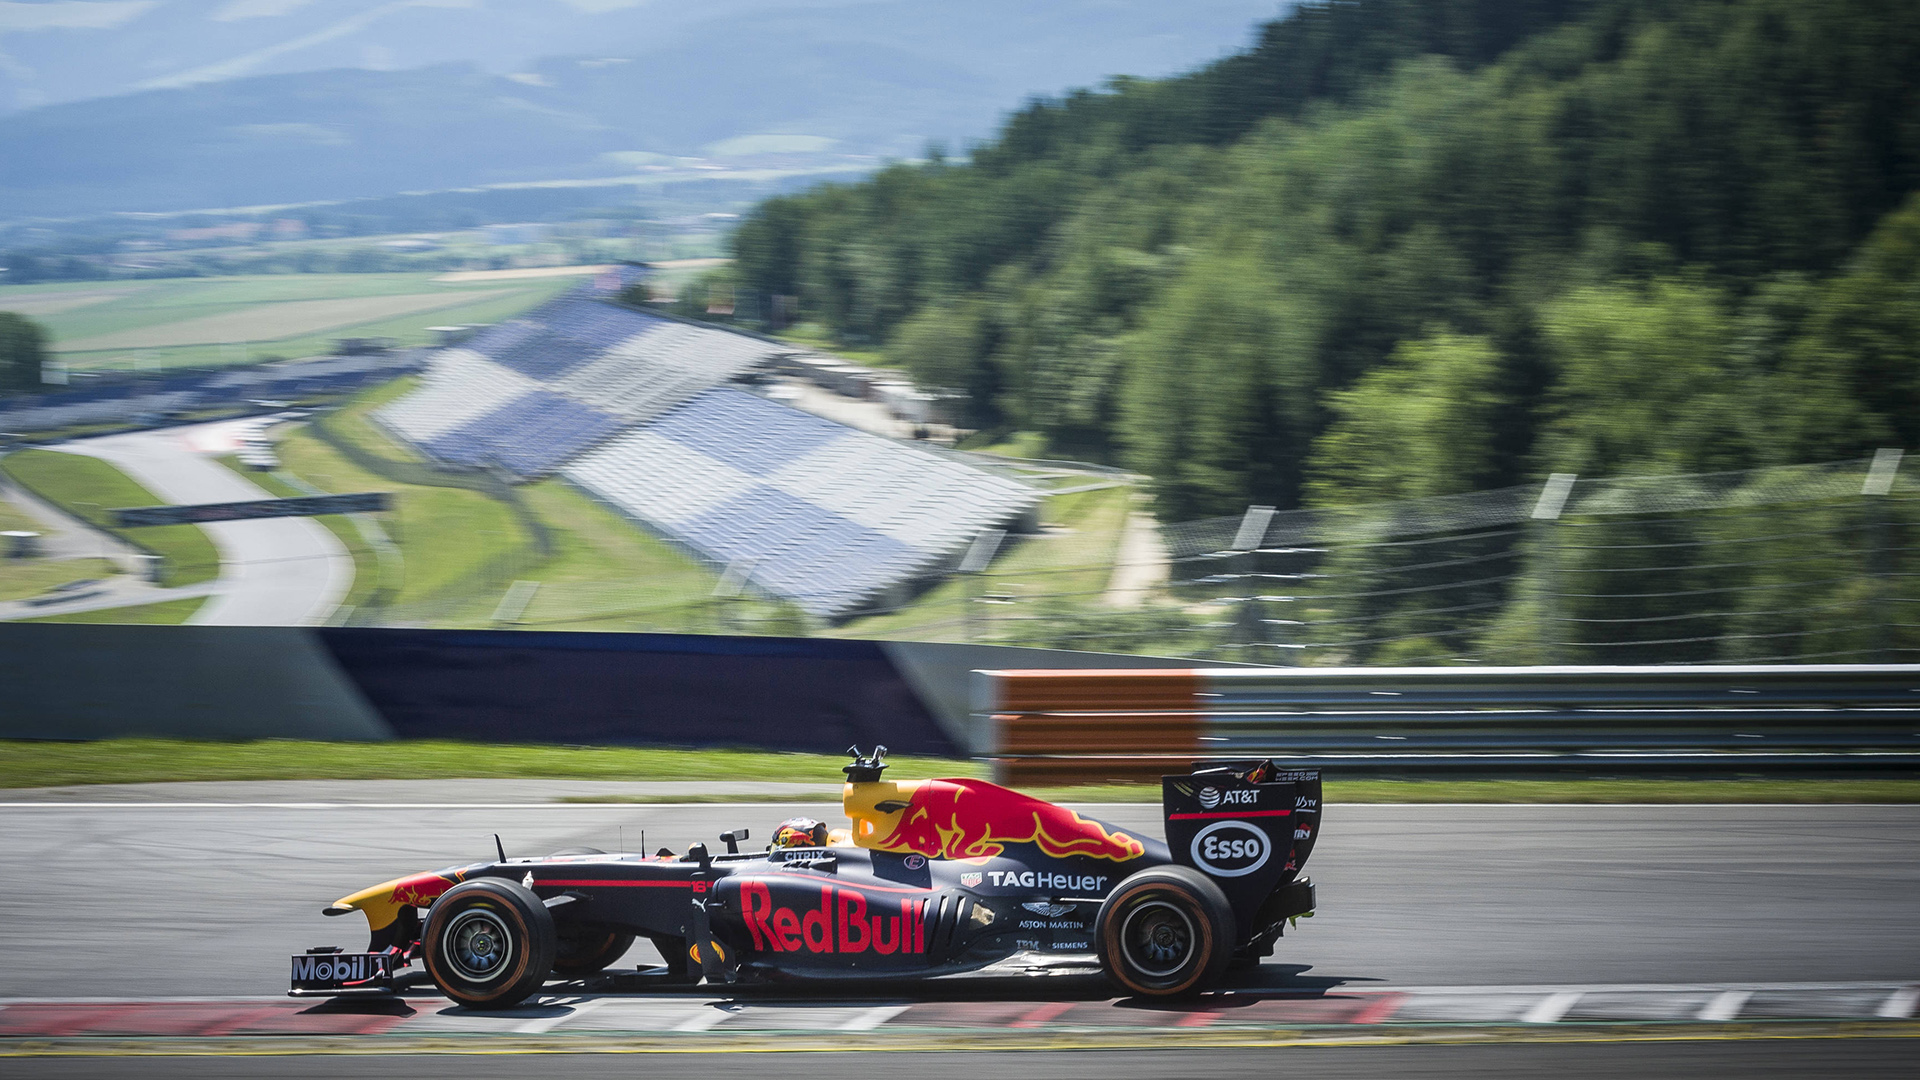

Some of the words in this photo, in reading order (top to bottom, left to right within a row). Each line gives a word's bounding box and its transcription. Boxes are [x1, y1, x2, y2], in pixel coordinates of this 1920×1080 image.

[1223, 789, 1260, 804] AT&T
[784, 851, 825, 861] CITRIX
[691, 881, 707, 893] 16
[1019, 920, 1047, 930] ASTON
[1049, 921, 1084, 929] MARTIN
[1016, 939, 1040, 951] IBM
[1052, 942, 1088, 950] SIEMENS
[292, 956, 365, 981] Mobil
